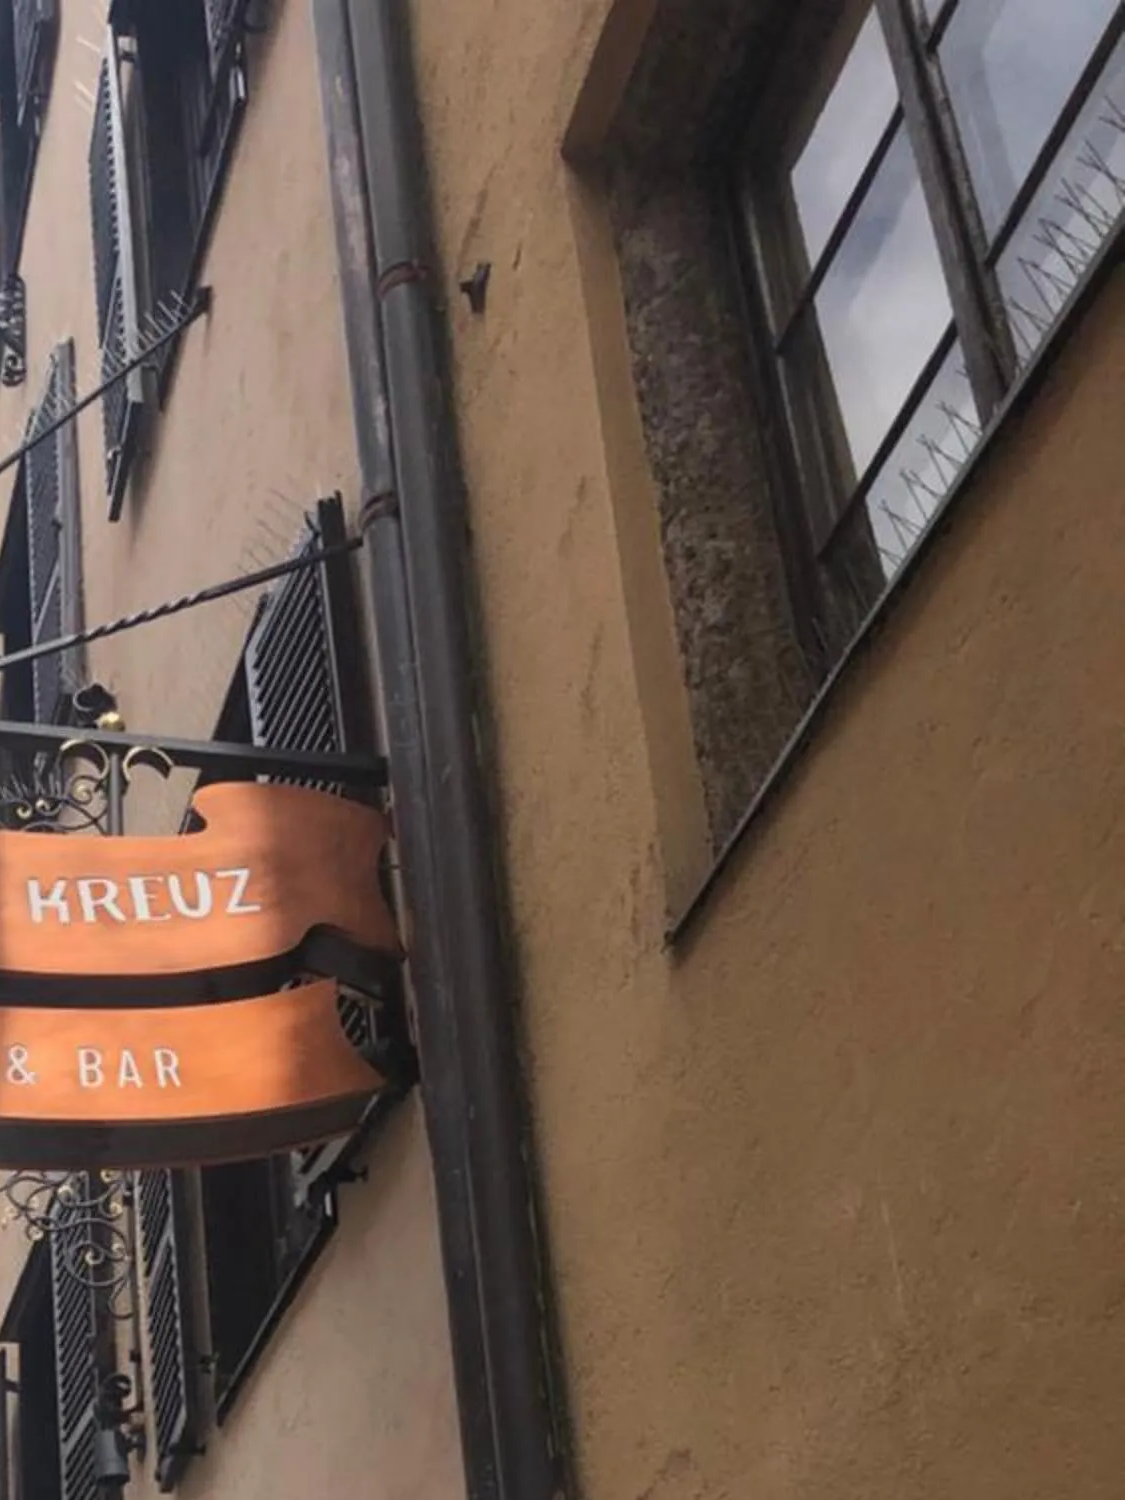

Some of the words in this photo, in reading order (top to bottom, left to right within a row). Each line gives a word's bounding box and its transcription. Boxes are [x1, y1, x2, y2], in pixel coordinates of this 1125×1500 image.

[27, 867, 263, 925] KREUZ
[6, 1047, 38, 1086] &
[78, 1047, 183, 1089] BAR
